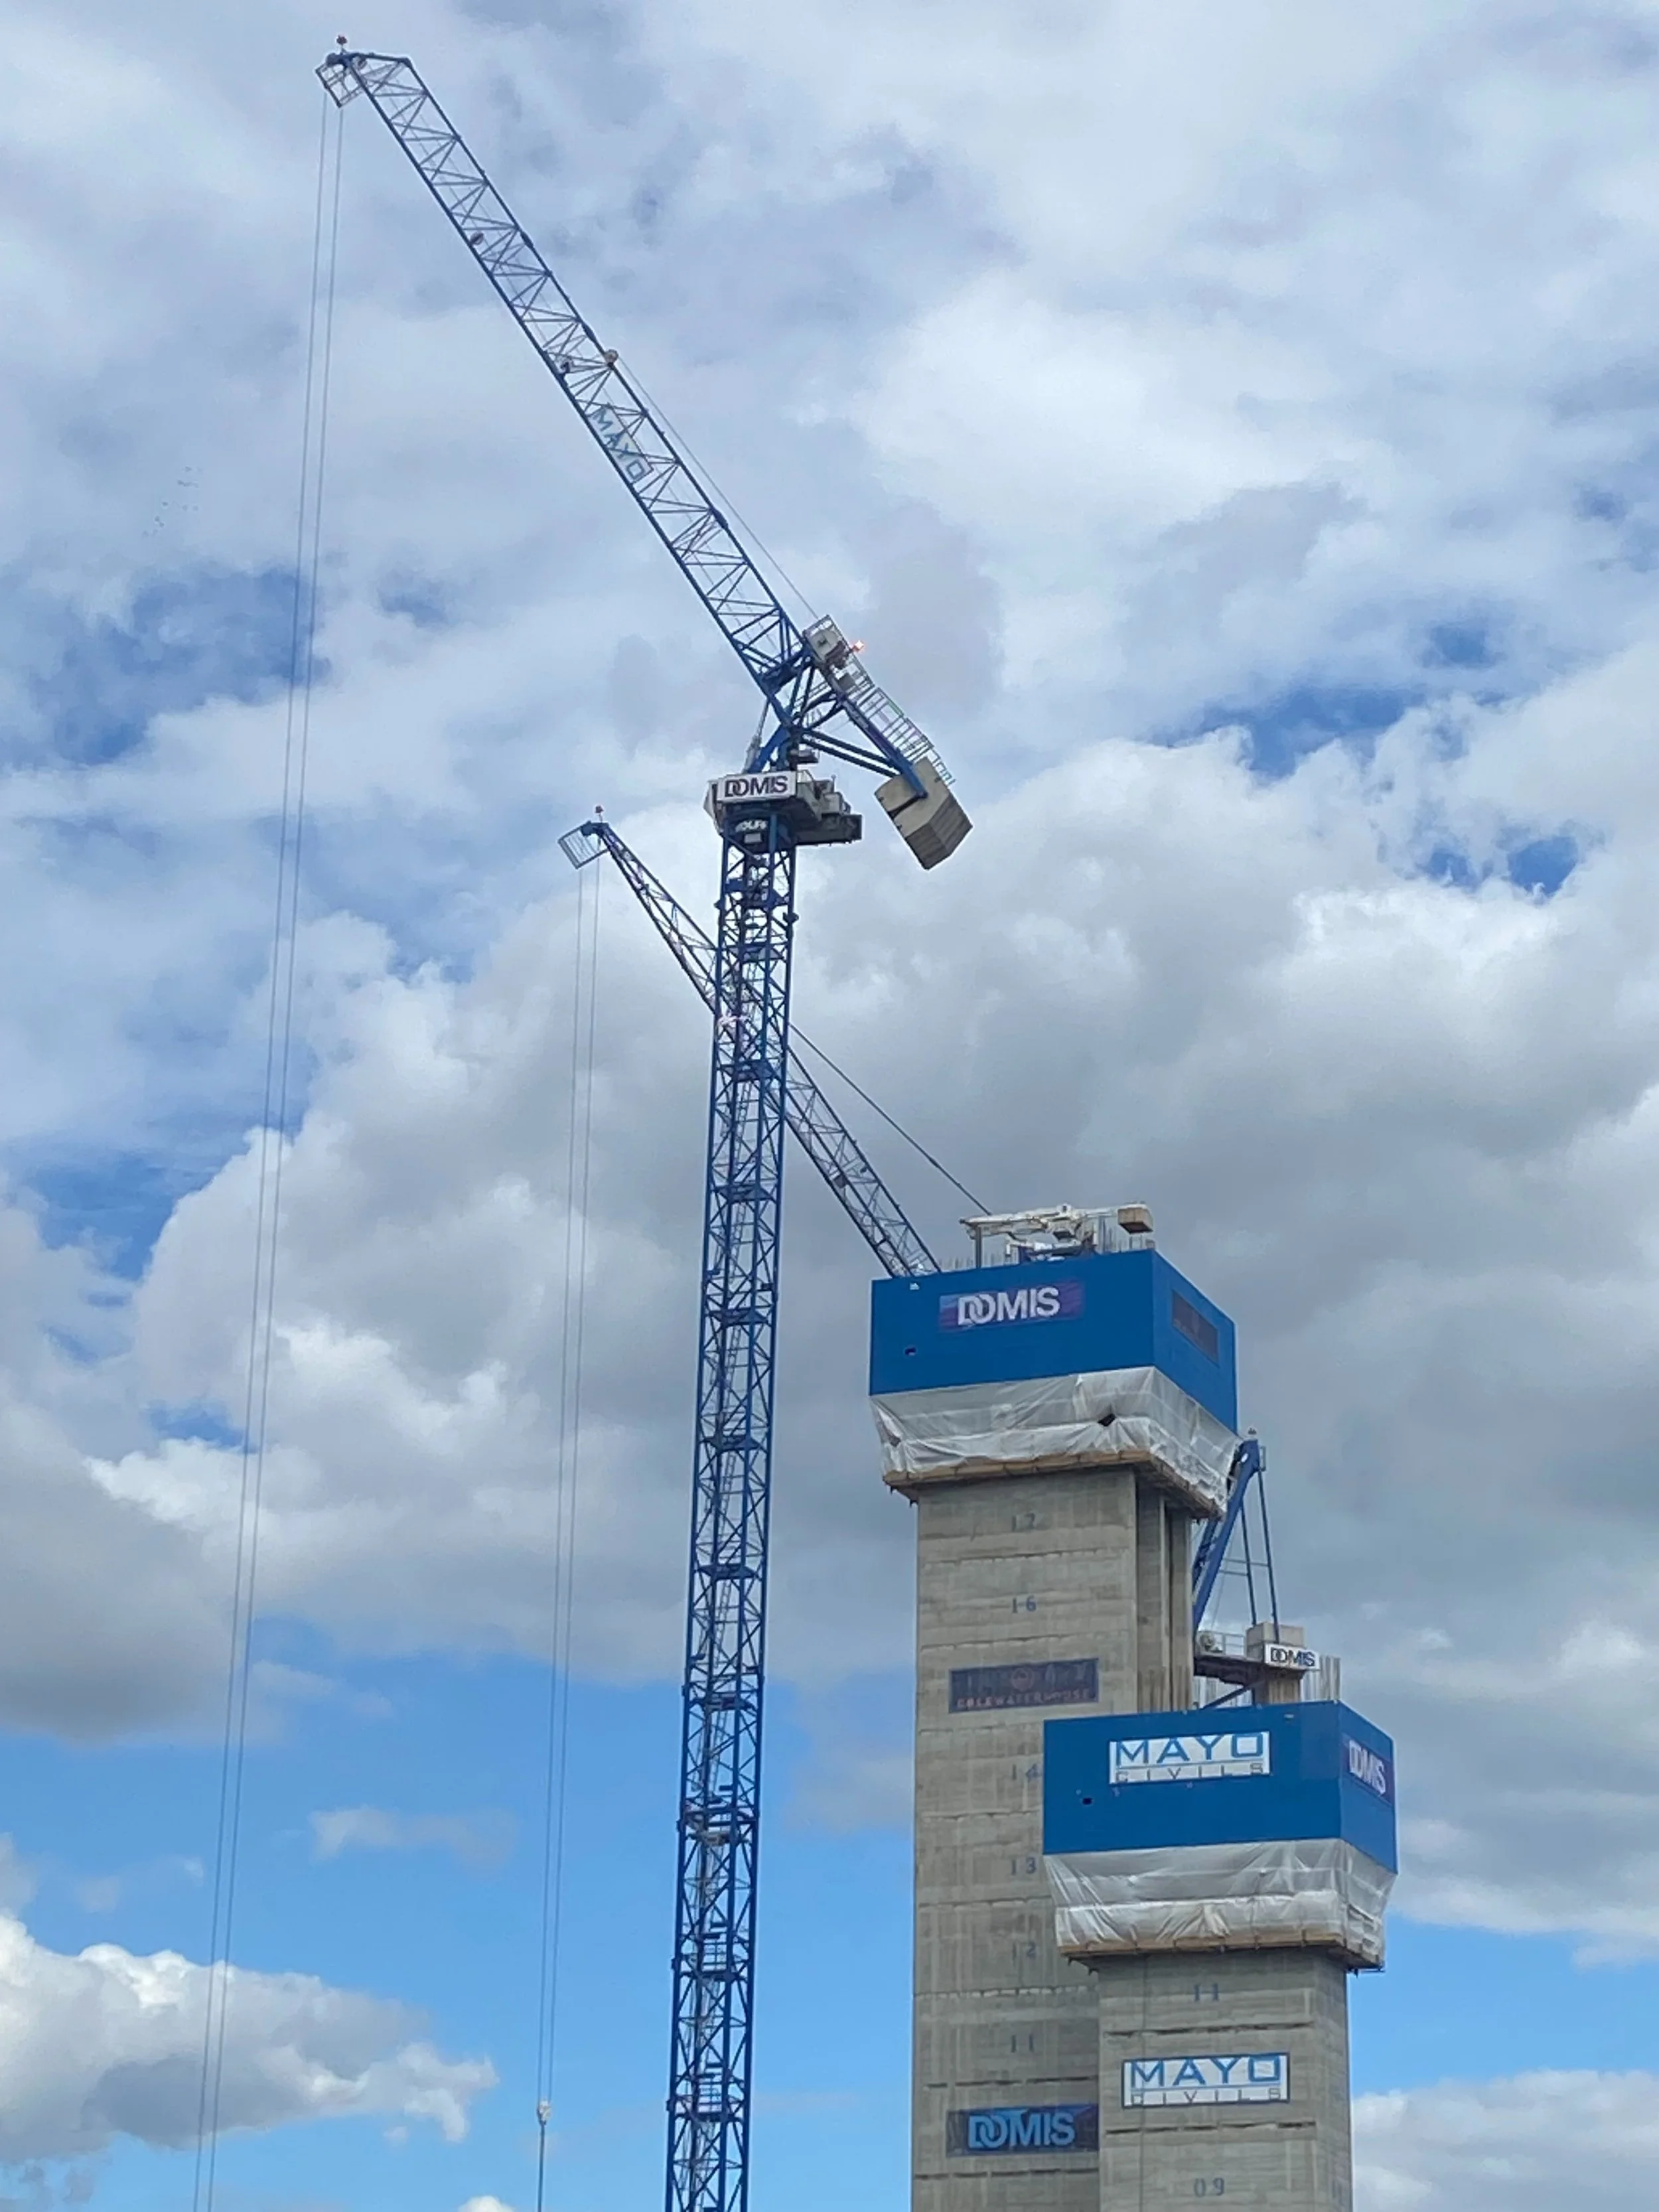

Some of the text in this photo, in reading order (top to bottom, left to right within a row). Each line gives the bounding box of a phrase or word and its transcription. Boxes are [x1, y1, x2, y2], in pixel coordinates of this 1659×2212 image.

[593, 407, 644, 480] MAYO
[725, 776, 788, 796] DOMIS
[958, 1287, 1060, 1325] DOMIS
[1011, 1595, 1037, 1613] 16
[1271, 1647, 1315, 1666] DOMIS
[1116, 1733, 1263, 1765] MAYO
[1349, 1739, 1386, 1795] DOMIS
[1011, 1858, 1037, 1876] 13
[1194, 1983, 1219, 2002] 11
[1011, 2034, 1035, 2053] 11
[1132, 2055, 1280, 2087] MAYO
[968, 2112, 1076, 2148] DOMIS
[1194, 2177, 1224, 2197] 09
